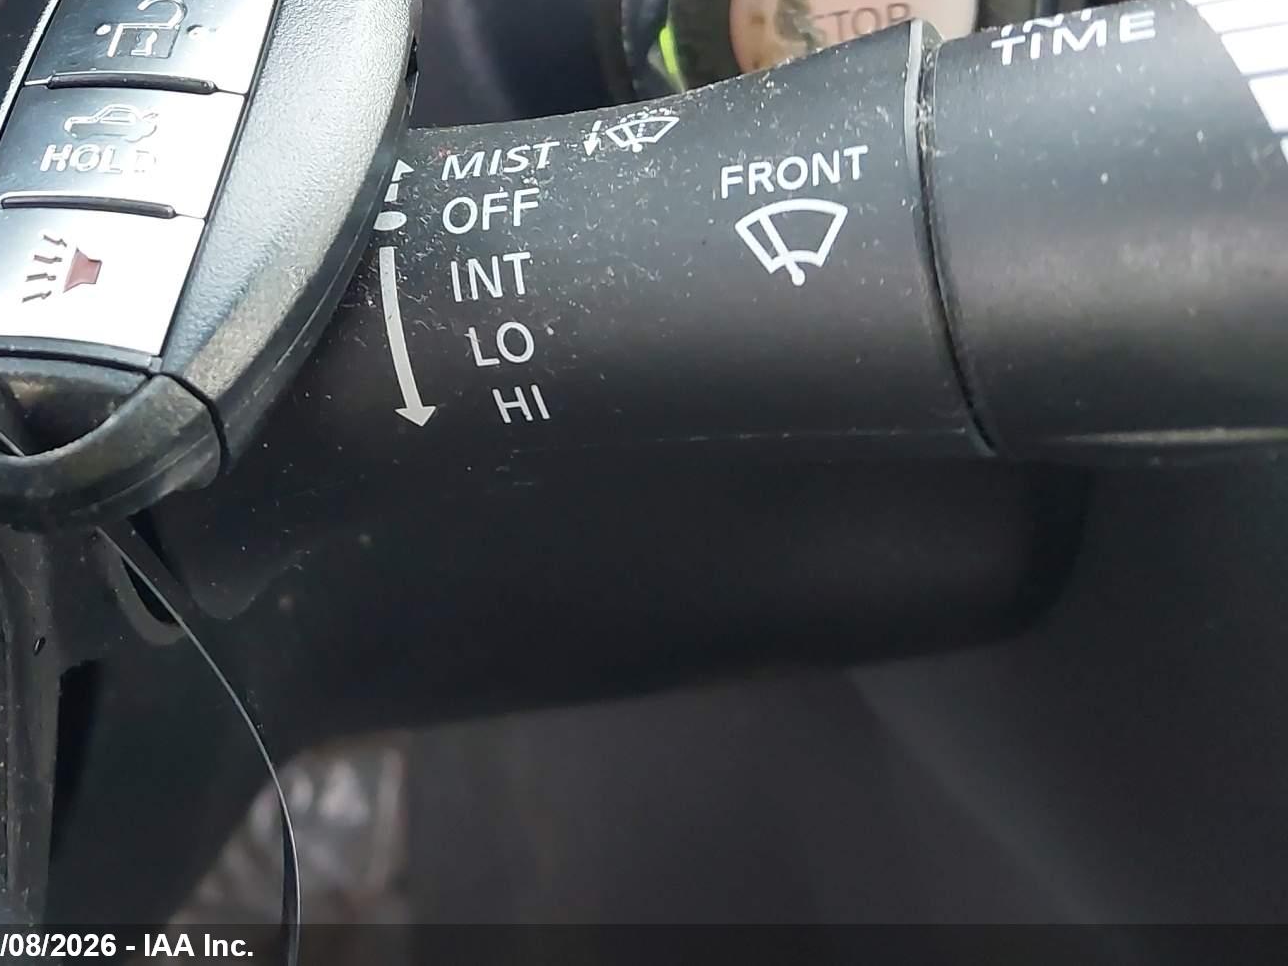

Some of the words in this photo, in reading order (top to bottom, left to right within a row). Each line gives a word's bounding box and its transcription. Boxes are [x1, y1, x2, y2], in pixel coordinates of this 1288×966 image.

[991, 10, 1156, 66] TIME
[39, 143, 159, 174] HOLD
[441, 141, 560, 181] MIST
[720, 145, 869, 199] FRONT
[441, 187, 540, 234] OFF
[450, 251, 532, 303] INT
[467, 321, 535, 367] LO
[492, 384, 551, 424] HI
